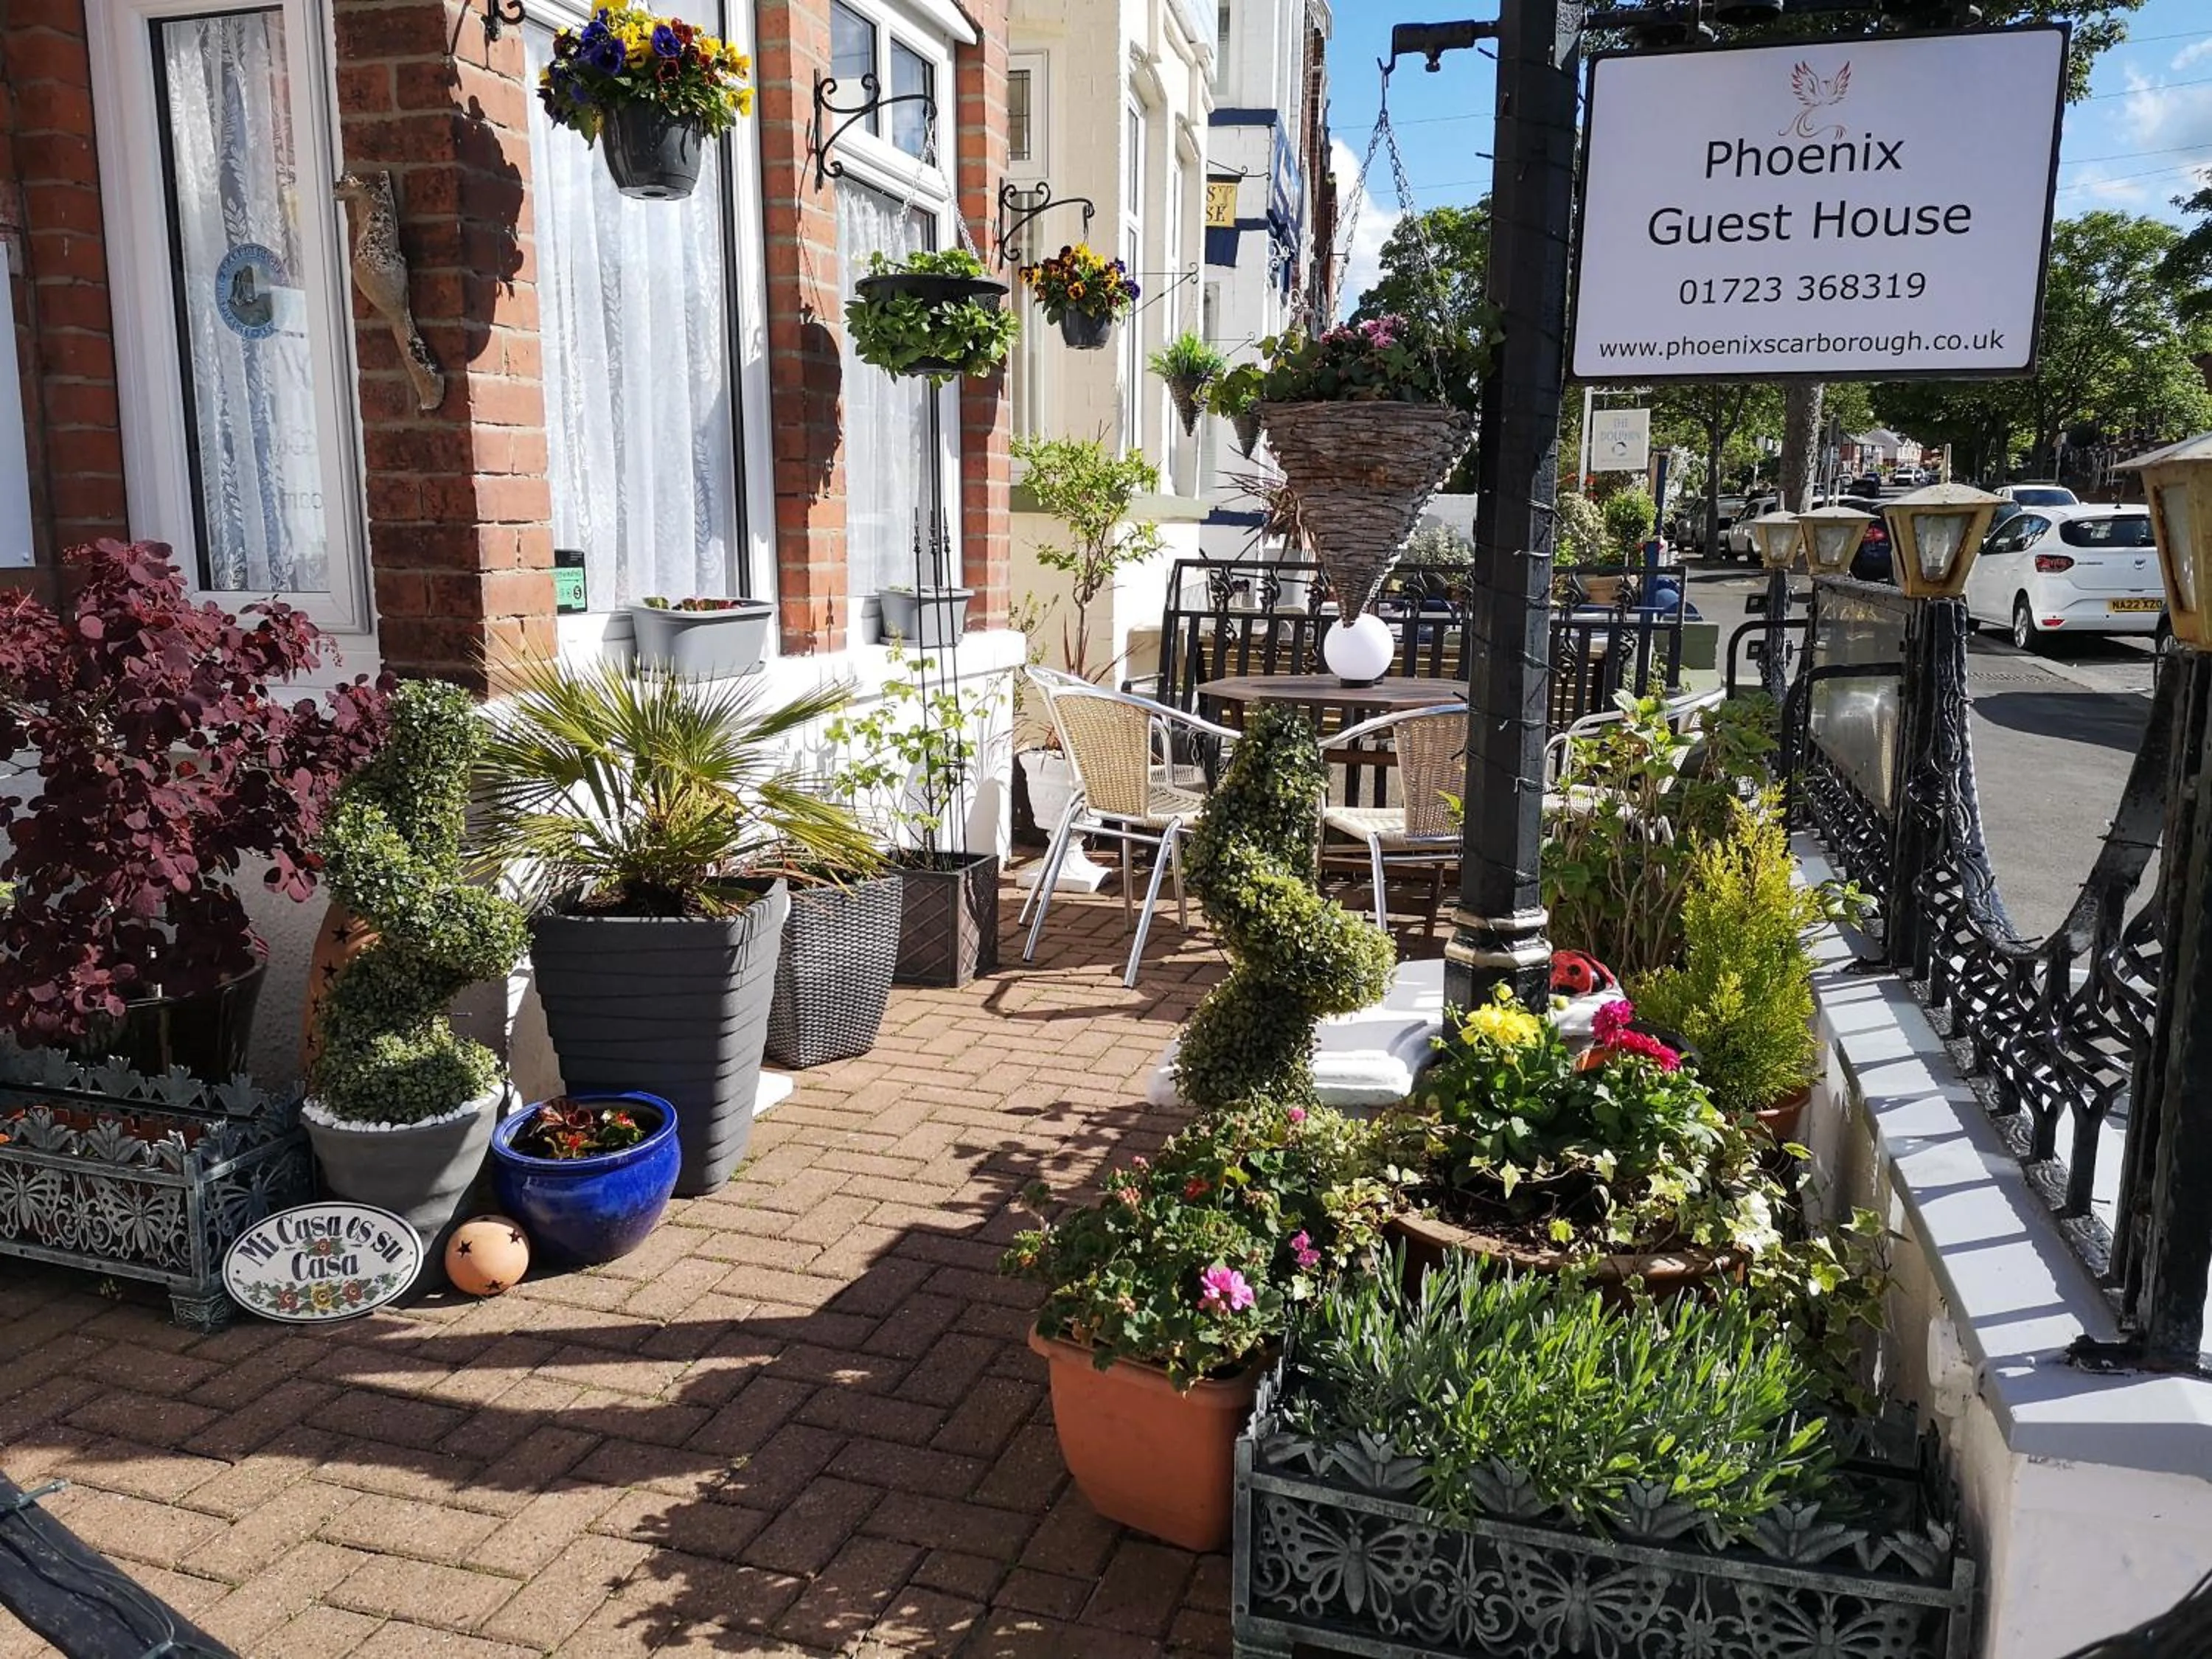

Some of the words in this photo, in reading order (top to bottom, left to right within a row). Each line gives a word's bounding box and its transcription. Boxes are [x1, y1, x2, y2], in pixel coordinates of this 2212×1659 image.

[1704, 133, 1905, 178] Phoenix
[1648, 204, 1791, 246] Guest
[1812, 201, 1971, 239] House
[1679, 276, 1782, 305] 01723
[1796, 272, 1927, 302] 368319
[1599, 329, 2005, 360] www.phoenixscarborough.co.uk
[236, 1231, 279, 1267] Mi
[276, 1214, 343, 1245] Casa
[291, 1251, 361, 1281] Casa
